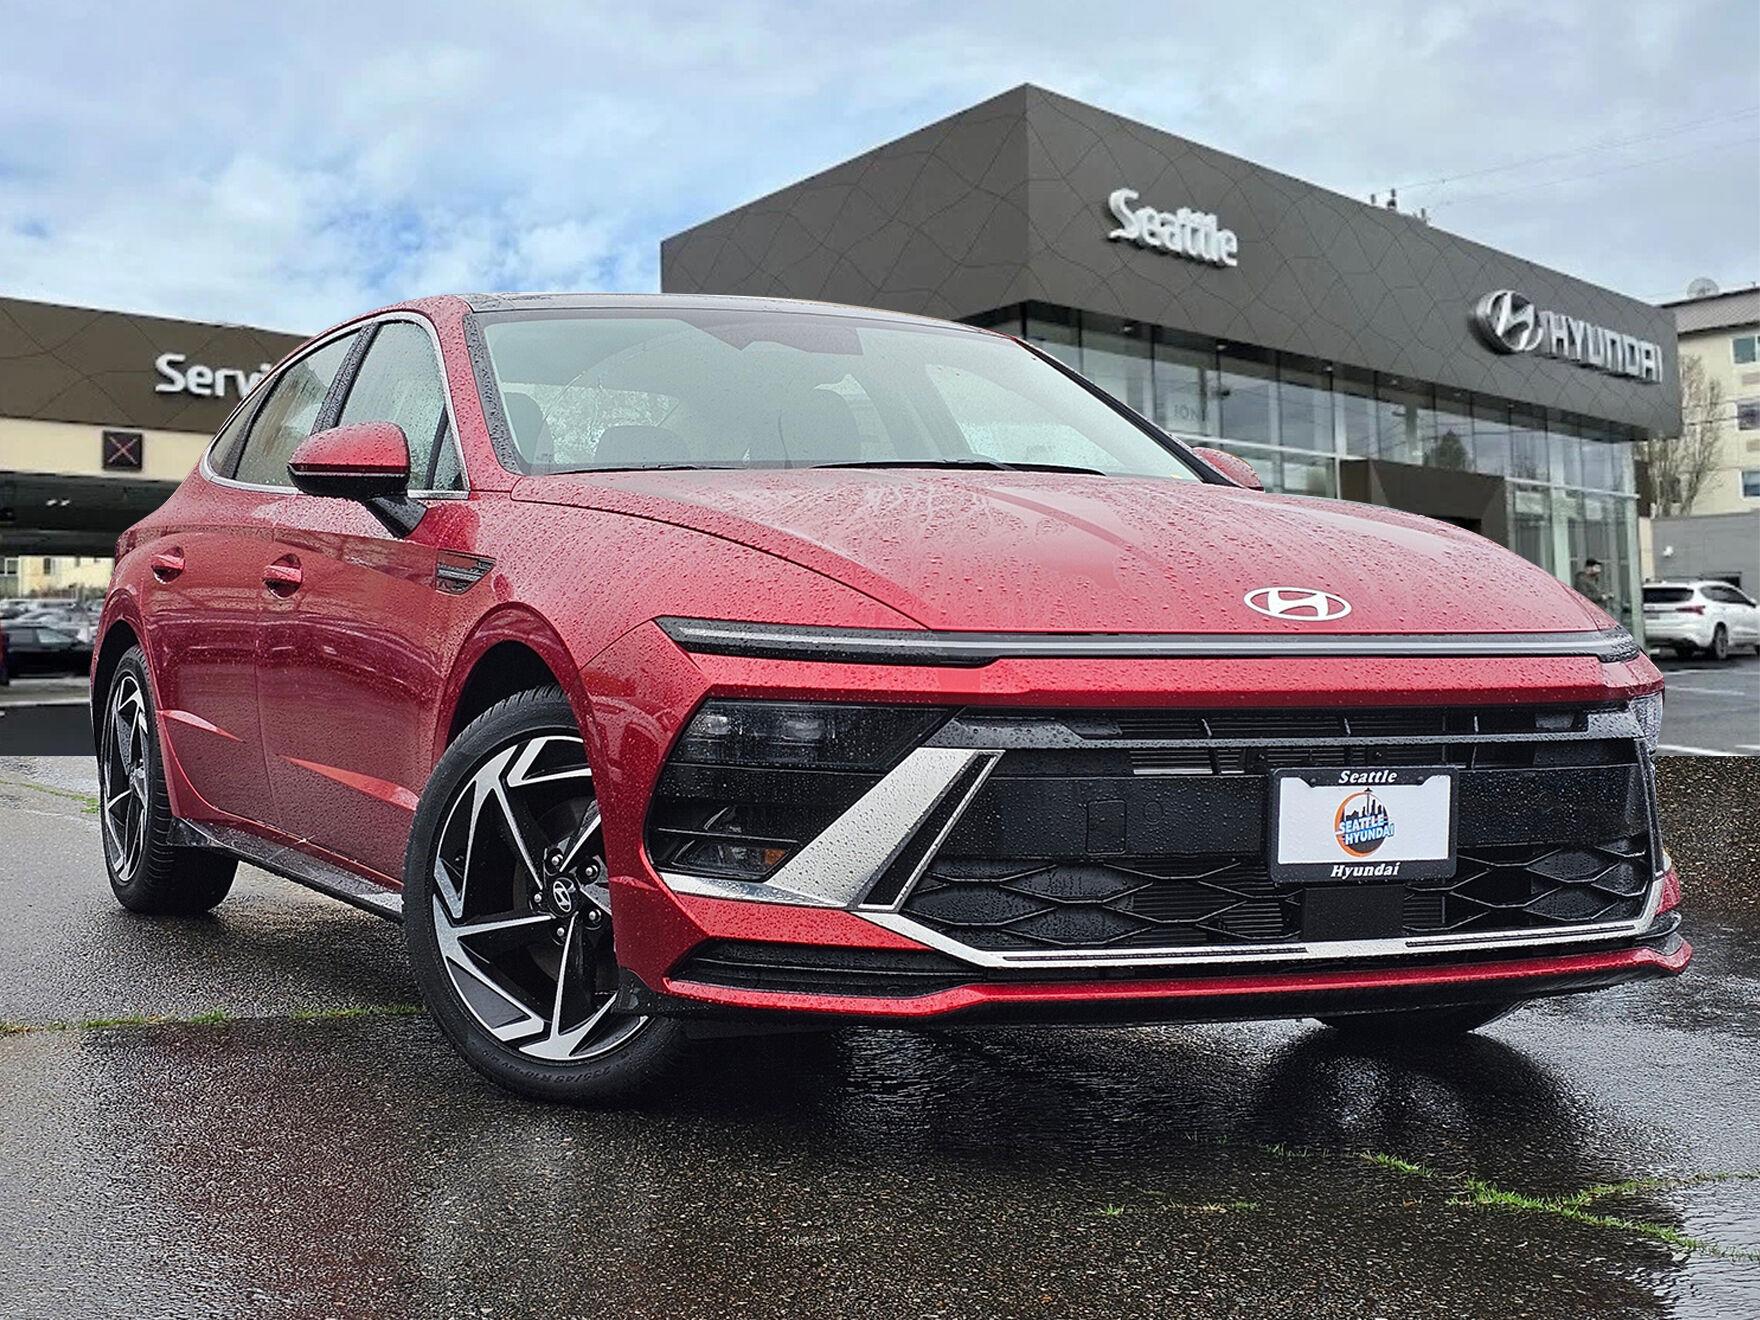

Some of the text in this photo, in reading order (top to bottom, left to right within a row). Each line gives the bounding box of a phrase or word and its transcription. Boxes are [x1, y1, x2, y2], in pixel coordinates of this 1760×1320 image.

[1109, 188, 1238, 267] Seattle
[1539, 310, 1663, 384] HYUNDAI
[155, 352, 273, 399] Serv
[1338, 770, 1398, 784] Seattle
[1339, 814, 1386, 833] SEATTLE
[1345, 822, 1395, 846] HYUNDAI
[1330, 862, 1401, 880] Hyundai
